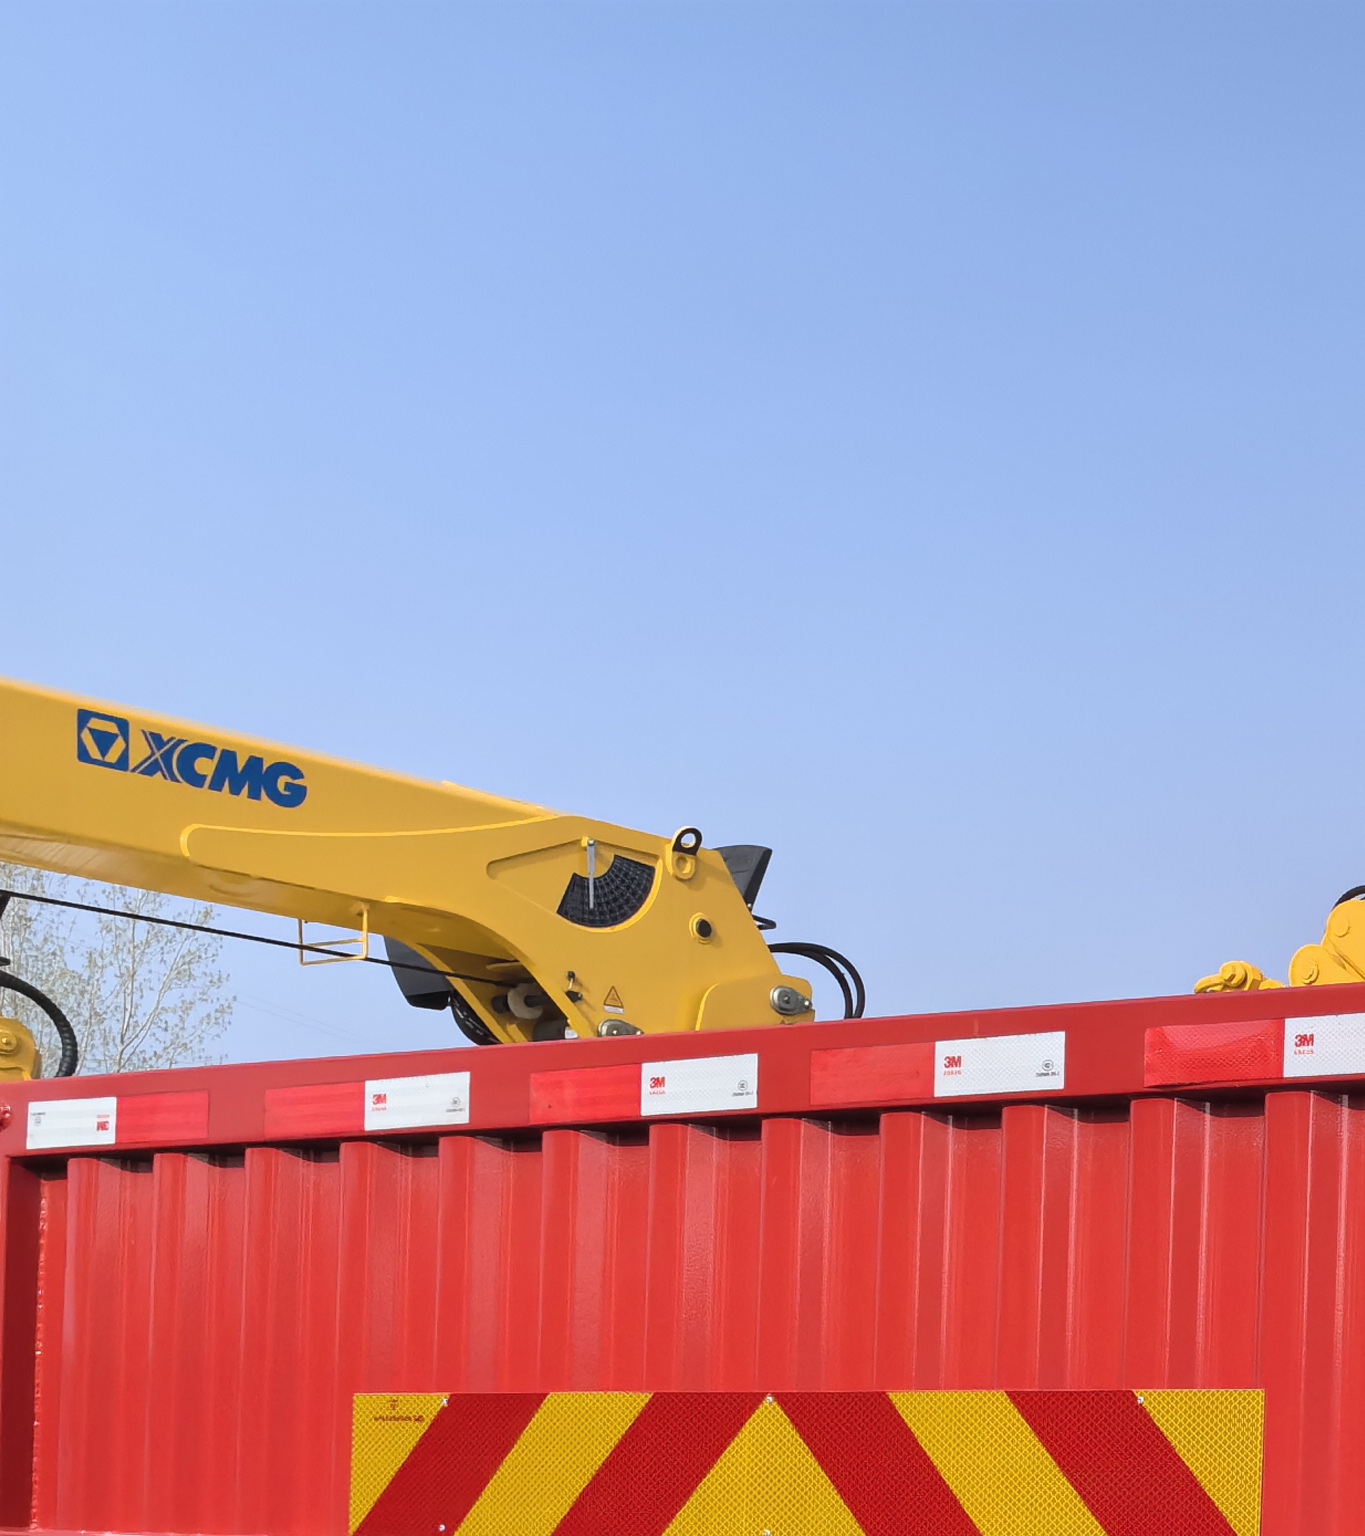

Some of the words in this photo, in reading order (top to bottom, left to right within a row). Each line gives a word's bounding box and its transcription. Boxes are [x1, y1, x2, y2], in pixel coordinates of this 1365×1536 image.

[130, 729, 307, 808] XCMG
[1295, 1034, 1314, 1047] 3M
[945, 1056, 962, 1068] 3M
[650, 1077, 665, 1089] 3M
[373, 1094, 387, 1105] 3M
[96, 1120, 109, 1131] 3M
